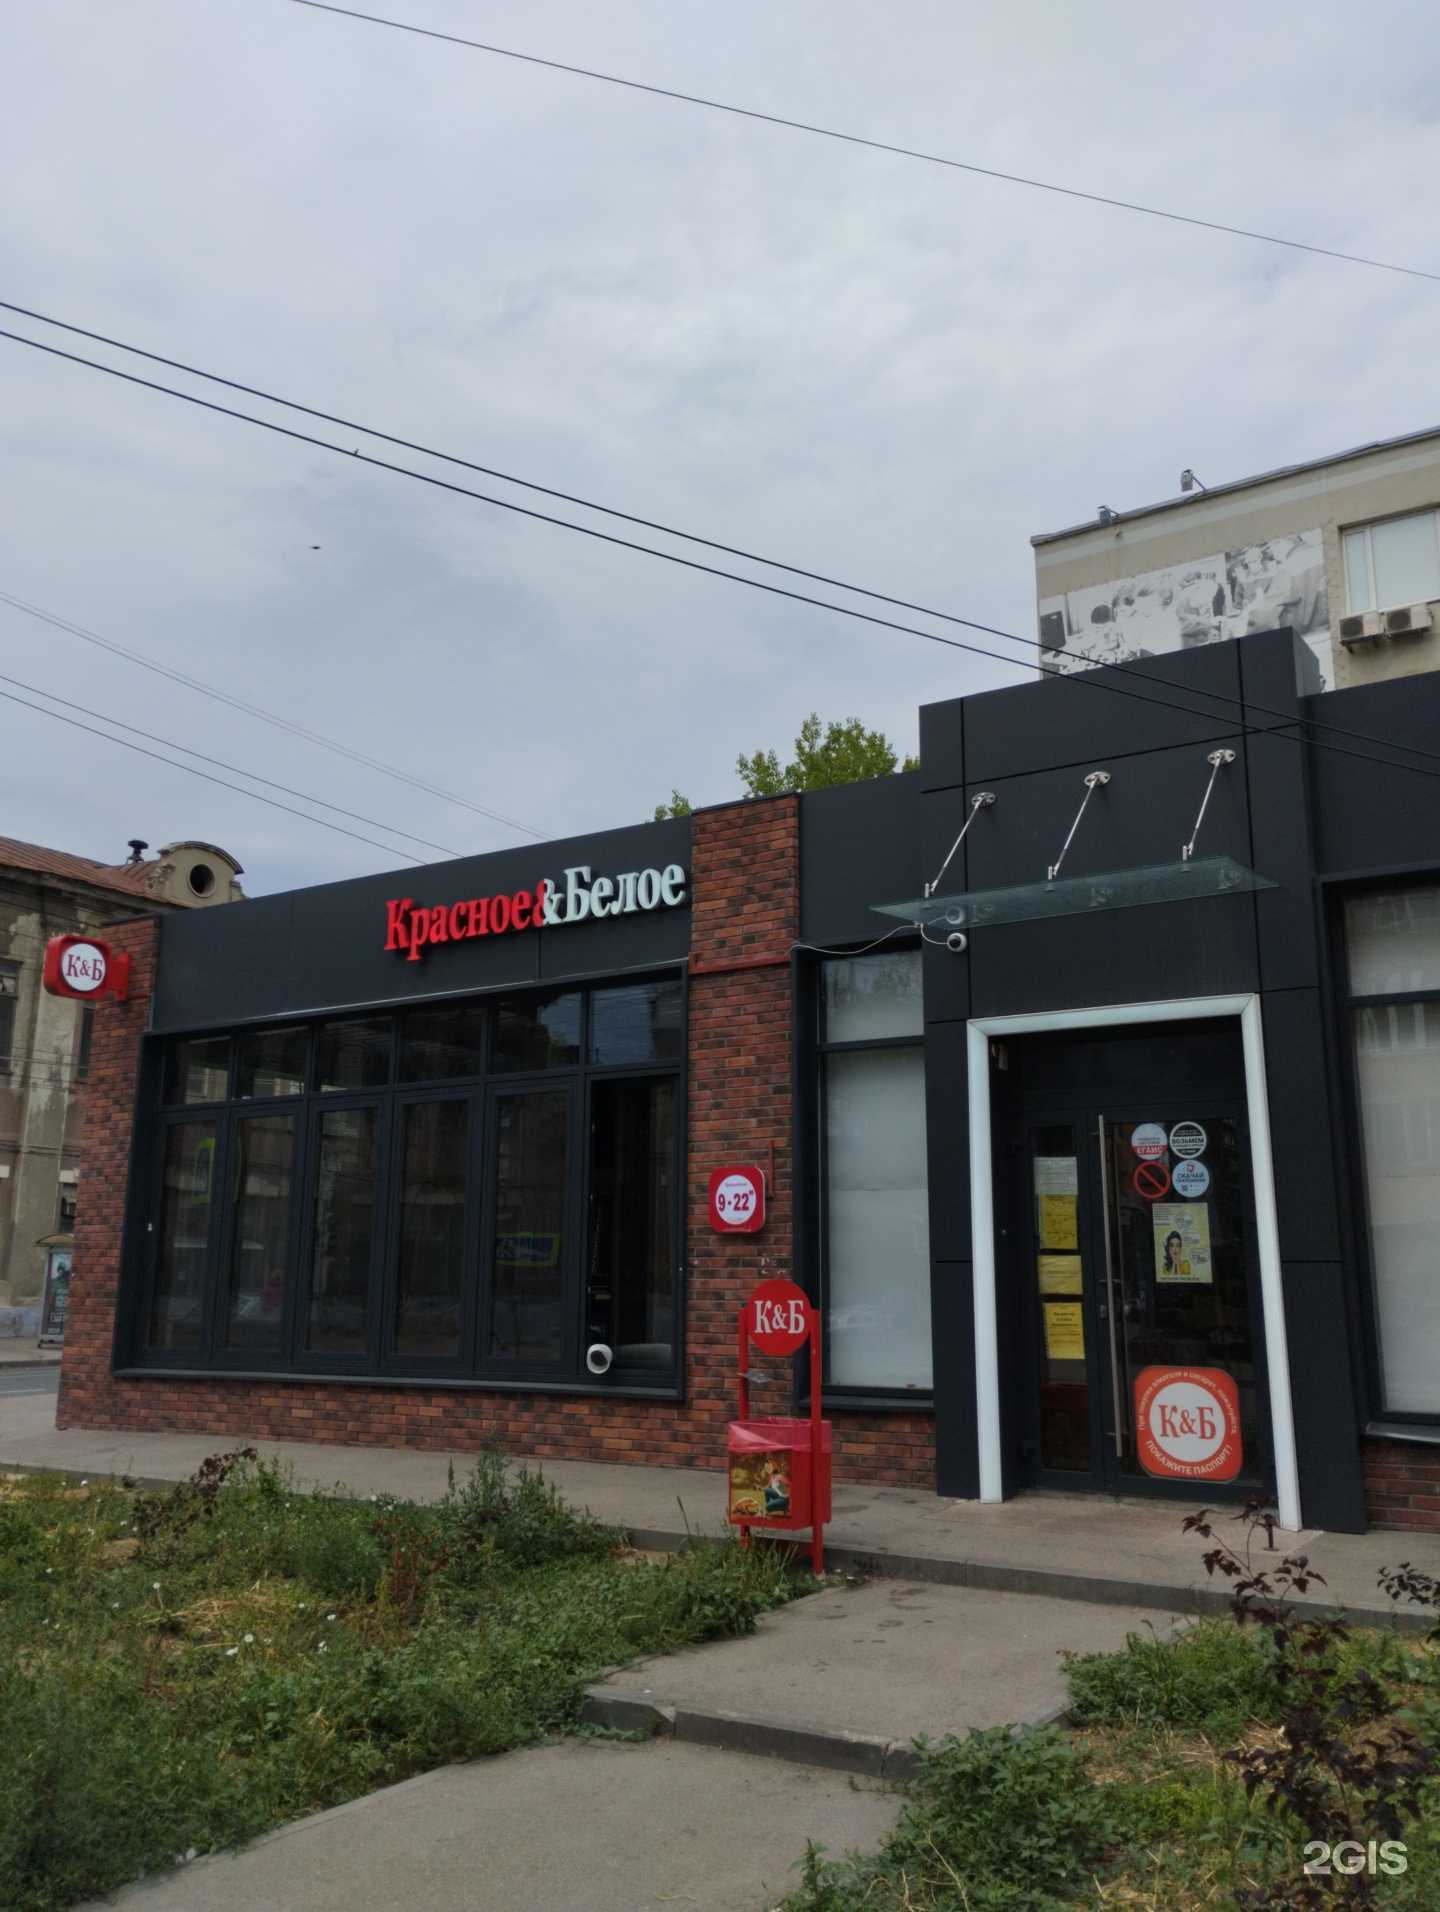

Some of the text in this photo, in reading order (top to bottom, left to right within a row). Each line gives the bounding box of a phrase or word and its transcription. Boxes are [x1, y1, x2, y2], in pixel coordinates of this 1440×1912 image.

[66, 954, 103, 981] К&Б
[754, 1300, 805, 1334] К&Б
[1158, 1404, 1217, 1440] К&Б
